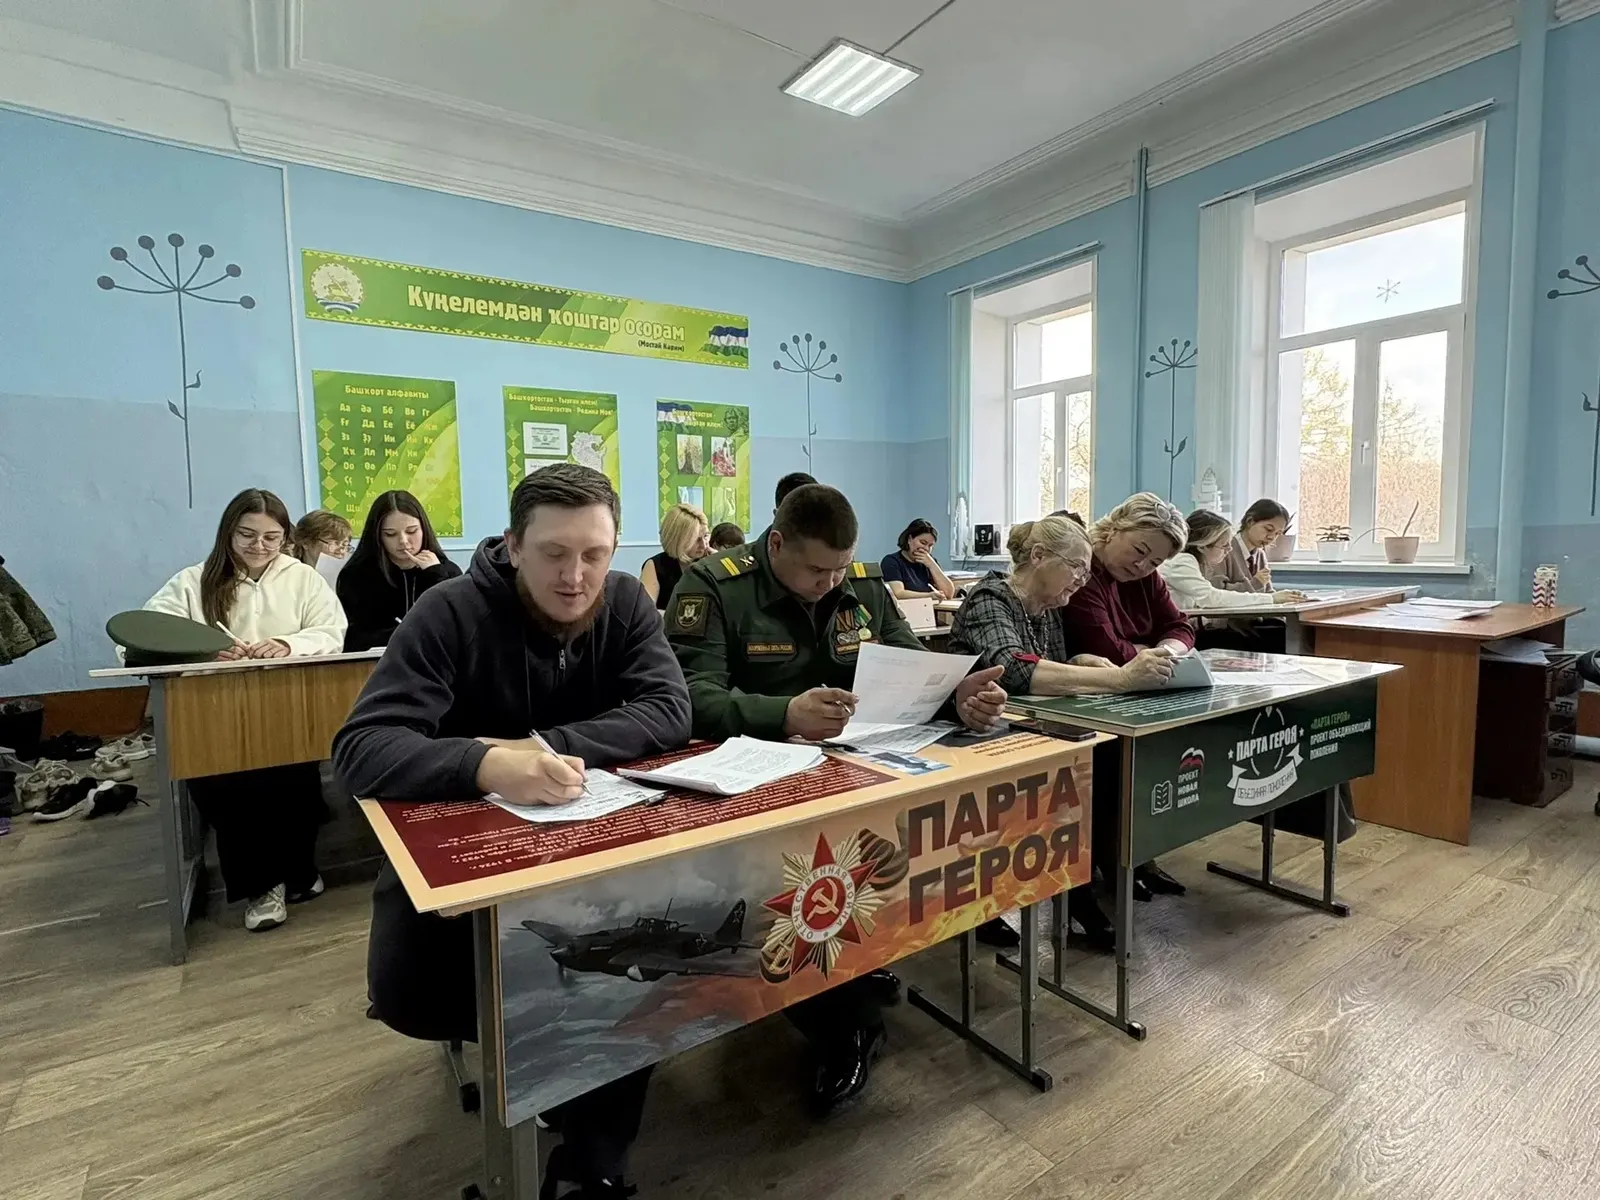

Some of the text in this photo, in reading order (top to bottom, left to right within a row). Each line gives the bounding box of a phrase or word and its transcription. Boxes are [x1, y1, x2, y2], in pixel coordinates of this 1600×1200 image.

[408, 284, 542, 322] Күңелемдән
[625, 318, 685, 341] осорам
[638, 340, 684, 352] (Мостай Карим)
[340, 403, 430, 416] Аа Әә Бб Вв Гг
[362, 419, 375, 428] Дд
[384, 420, 393, 429] Ее
[406, 420, 415, 430] Ёё
[341, 432, 350, 440] Зз
[364, 448, 375, 456] Лл
[385, 448, 398, 457] Мм
[343, 462, 354, 470] Оо
[1331, 711, 1350, 725] ГЕРОЯ»
[1310, 718, 1371, 745] ПРОЕКТ ОБЪЕДИНЯЮЩИЙ
[1236, 724, 1298, 762] ПАРТА ГЕРОЯ
[1310, 742, 1338, 760] ПОКОЛЕНИЯ
[1178, 769, 1199, 783] ПРОЕКТ
[1178, 781, 1198, 795] НОВАЯ
[1178, 794, 1199, 808] ШКОЛА
[908, 766, 1080, 859] ПАРТА
[909, 821, 1079, 926] ГЕРОЯ
[794, 866, 854, 940] ОТЕЧЕСТВЕННАЯ ВОЙНА
